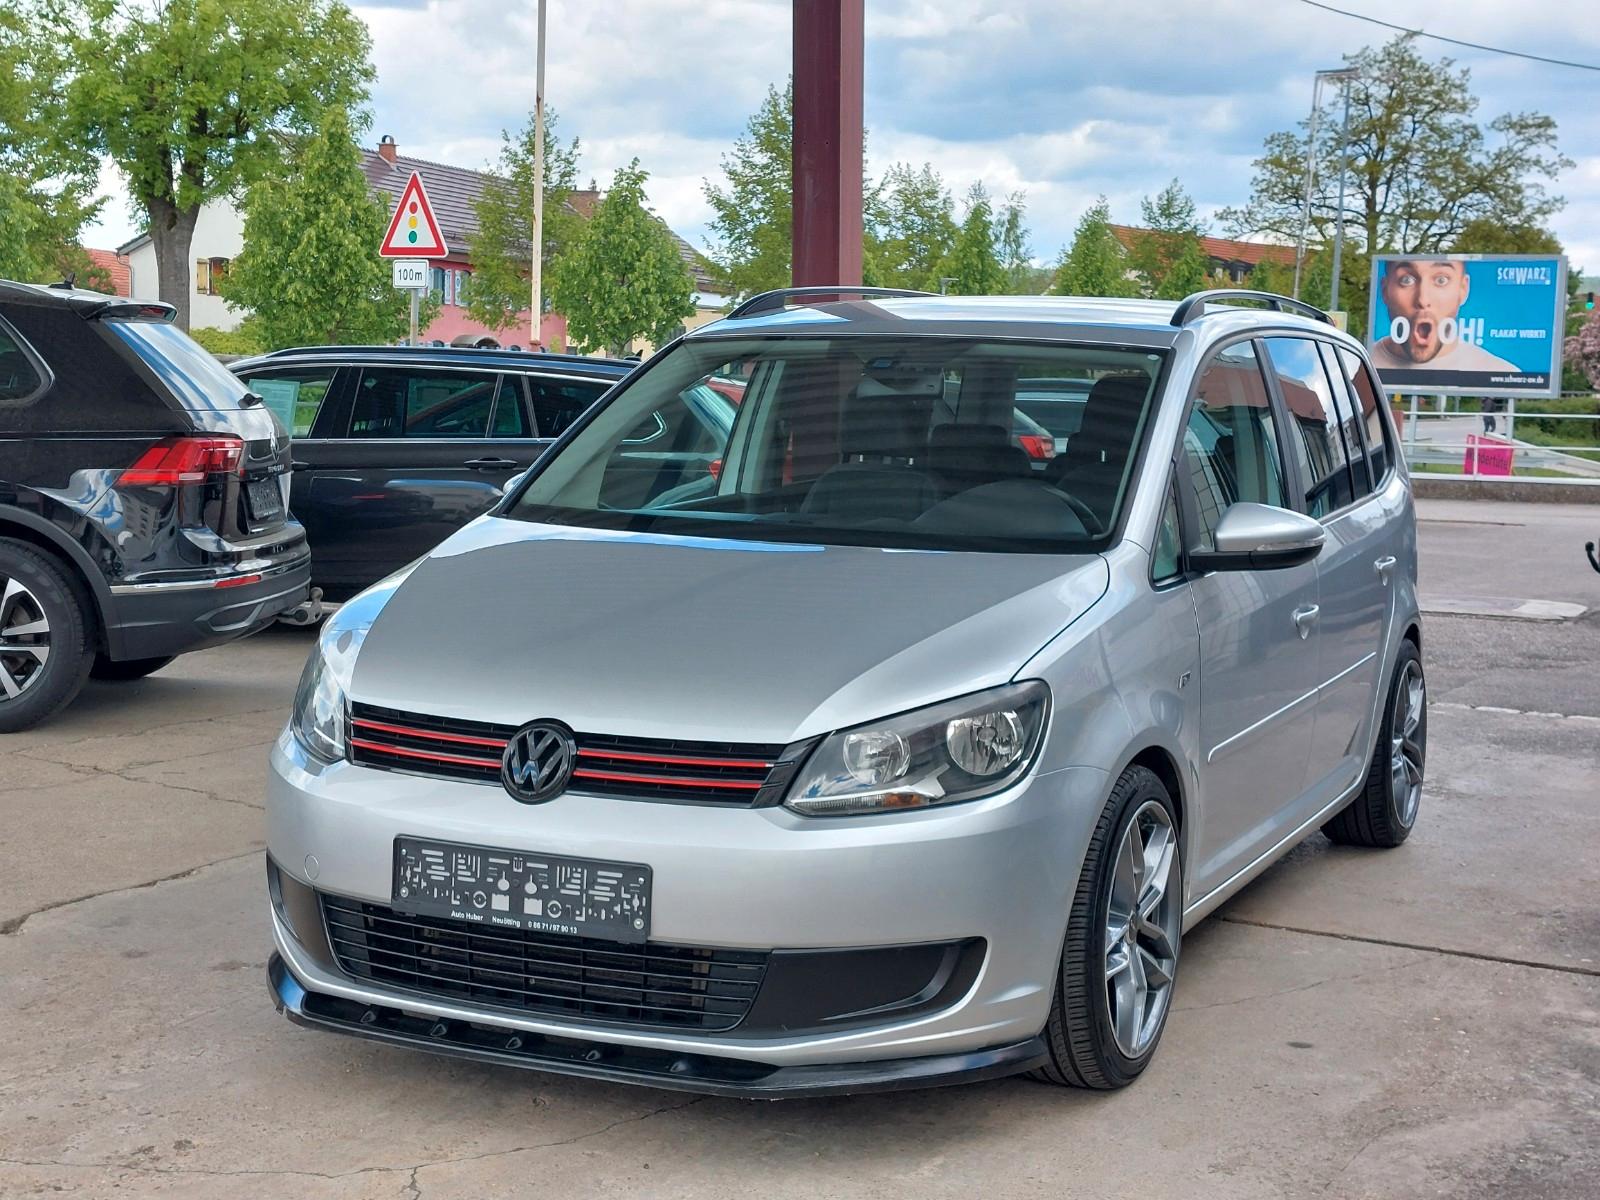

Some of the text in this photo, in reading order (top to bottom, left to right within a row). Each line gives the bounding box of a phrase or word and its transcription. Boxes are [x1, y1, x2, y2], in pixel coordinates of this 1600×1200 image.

[398, 268, 423, 281] 100m
[1490, 329, 1518, 338] PLAKAT
[451, 910, 484, 921] Auto Huber
